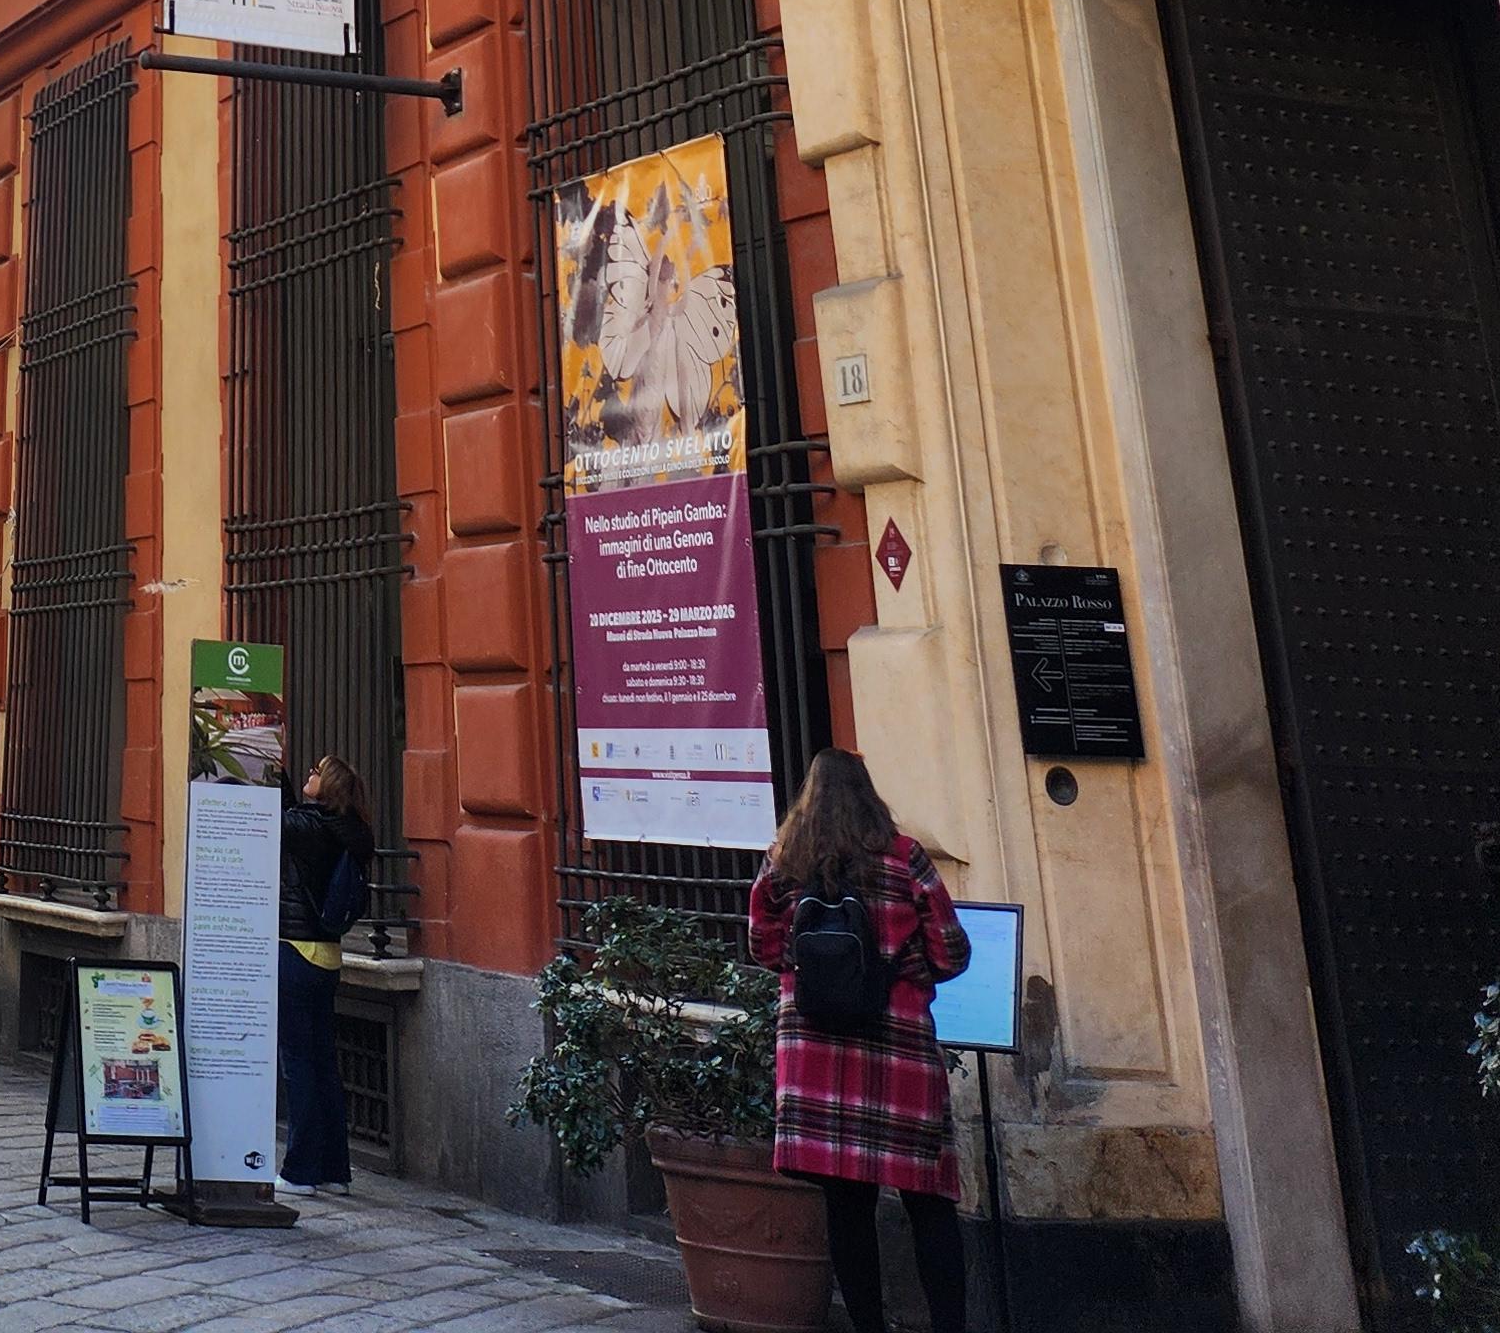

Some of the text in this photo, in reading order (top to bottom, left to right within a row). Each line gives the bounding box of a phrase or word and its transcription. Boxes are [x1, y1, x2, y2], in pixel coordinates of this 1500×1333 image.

[841, 364, 863, 397] 18
[575, 430, 733, 473] OTTOCENTO SVELATO
[585, 501, 727, 534] Nello studio di Pipein Gamba:
[599, 530, 714, 558] immagini di una Genova
[616, 556, 698, 580] di fine Ottocento
[589, 613, 599, 627] 20
[599, 611, 641, 626] DICEMBRE
[642, 608, 662, 624] 2025
[668, 608, 680, 623] 29
[680, 605, 712, 621] MARZO
[712, 603, 735, 620] 2026
